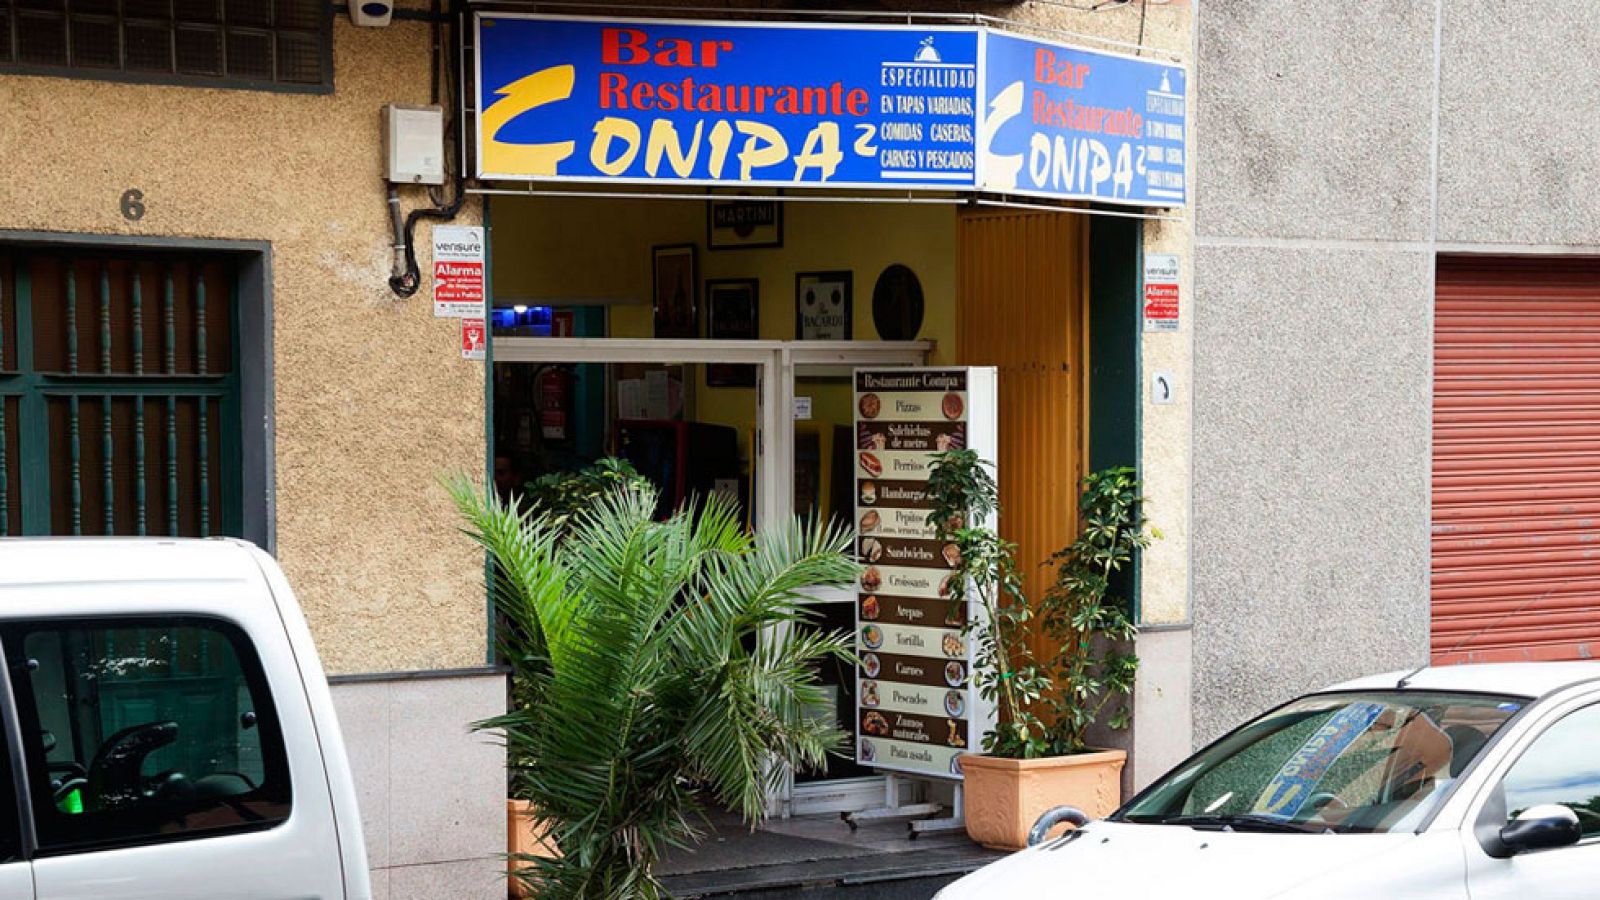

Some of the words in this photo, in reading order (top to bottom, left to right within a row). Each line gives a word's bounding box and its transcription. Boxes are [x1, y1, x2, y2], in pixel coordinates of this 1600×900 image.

[600, 27, 734, 68] Bar
[1034, 48, 1091, 89] Bar
[881, 67, 975, 88] ESPECIALIDAD
[599, 72, 870, 117] Restaurante
[880, 95, 894, 114] EN
[896, 95, 925, 115] TAPAS
[927, 95, 975, 118] VARIADAS,
[1032, 89, 1144, 140] Restaurante
[854, 124, 878, 157] 2
[880, 122, 923, 142] COMIDAS
[930, 123, 974, 145] CASERAS,
[880, 150, 916, 169] CARNES
[917, 151, 925, 169] Y
[926, 151, 974, 170] PESCADOS
[120, 188, 145, 221] 6
[716, 204, 775, 223] MARTINI
[437, 264, 481, 276] Alarma
[864, 373, 921, 388] Restaurante
[922, 373, 958, 390] Conipa
[895, 400, 921, 413] Pizzas
[888, 424, 931, 437] Salchichas
[902, 439, 928, 449] metro
[894, 458, 924, 471] Perritos
[895, 511, 923, 525] Pepitos
[886, 546, 933, 560] Sandwiches
[889, 574, 930, 589] Croissants
[897, 605, 924, 620] Arepas
[896, 633, 925, 648] Tortilla
[895, 662, 924, 676] Carnes
[892, 690, 928, 704] Pescados
[896, 714, 924, 728] Zumos
[892, 729, 930, 741] naturales
[890, 745, 910, 759] Pata
[910, 748, 933, 762] asada
